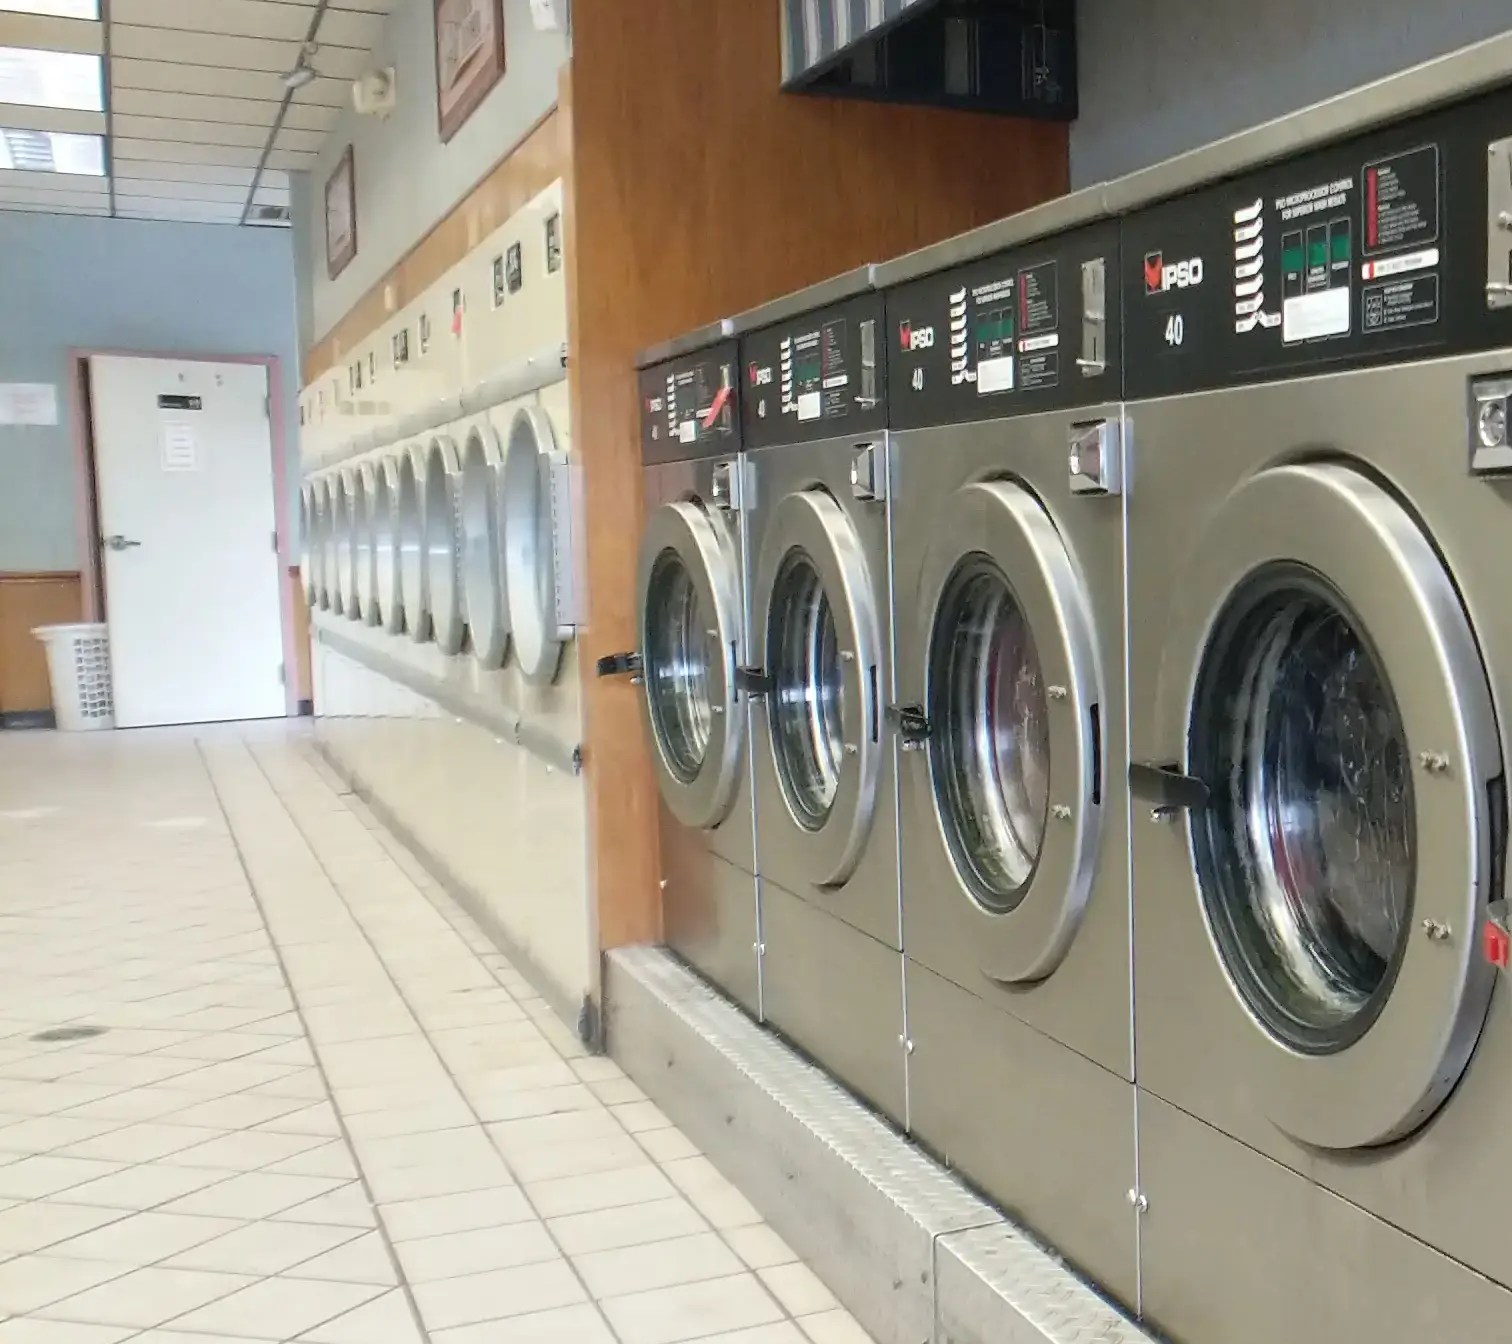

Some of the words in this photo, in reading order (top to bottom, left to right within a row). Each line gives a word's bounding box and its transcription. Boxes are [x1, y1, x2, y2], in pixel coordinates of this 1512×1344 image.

[1162, 257, 1204, 291] IPSO
[910, 326, 935, 351] IPSO
[1165, 314, 1184, 346] 40
